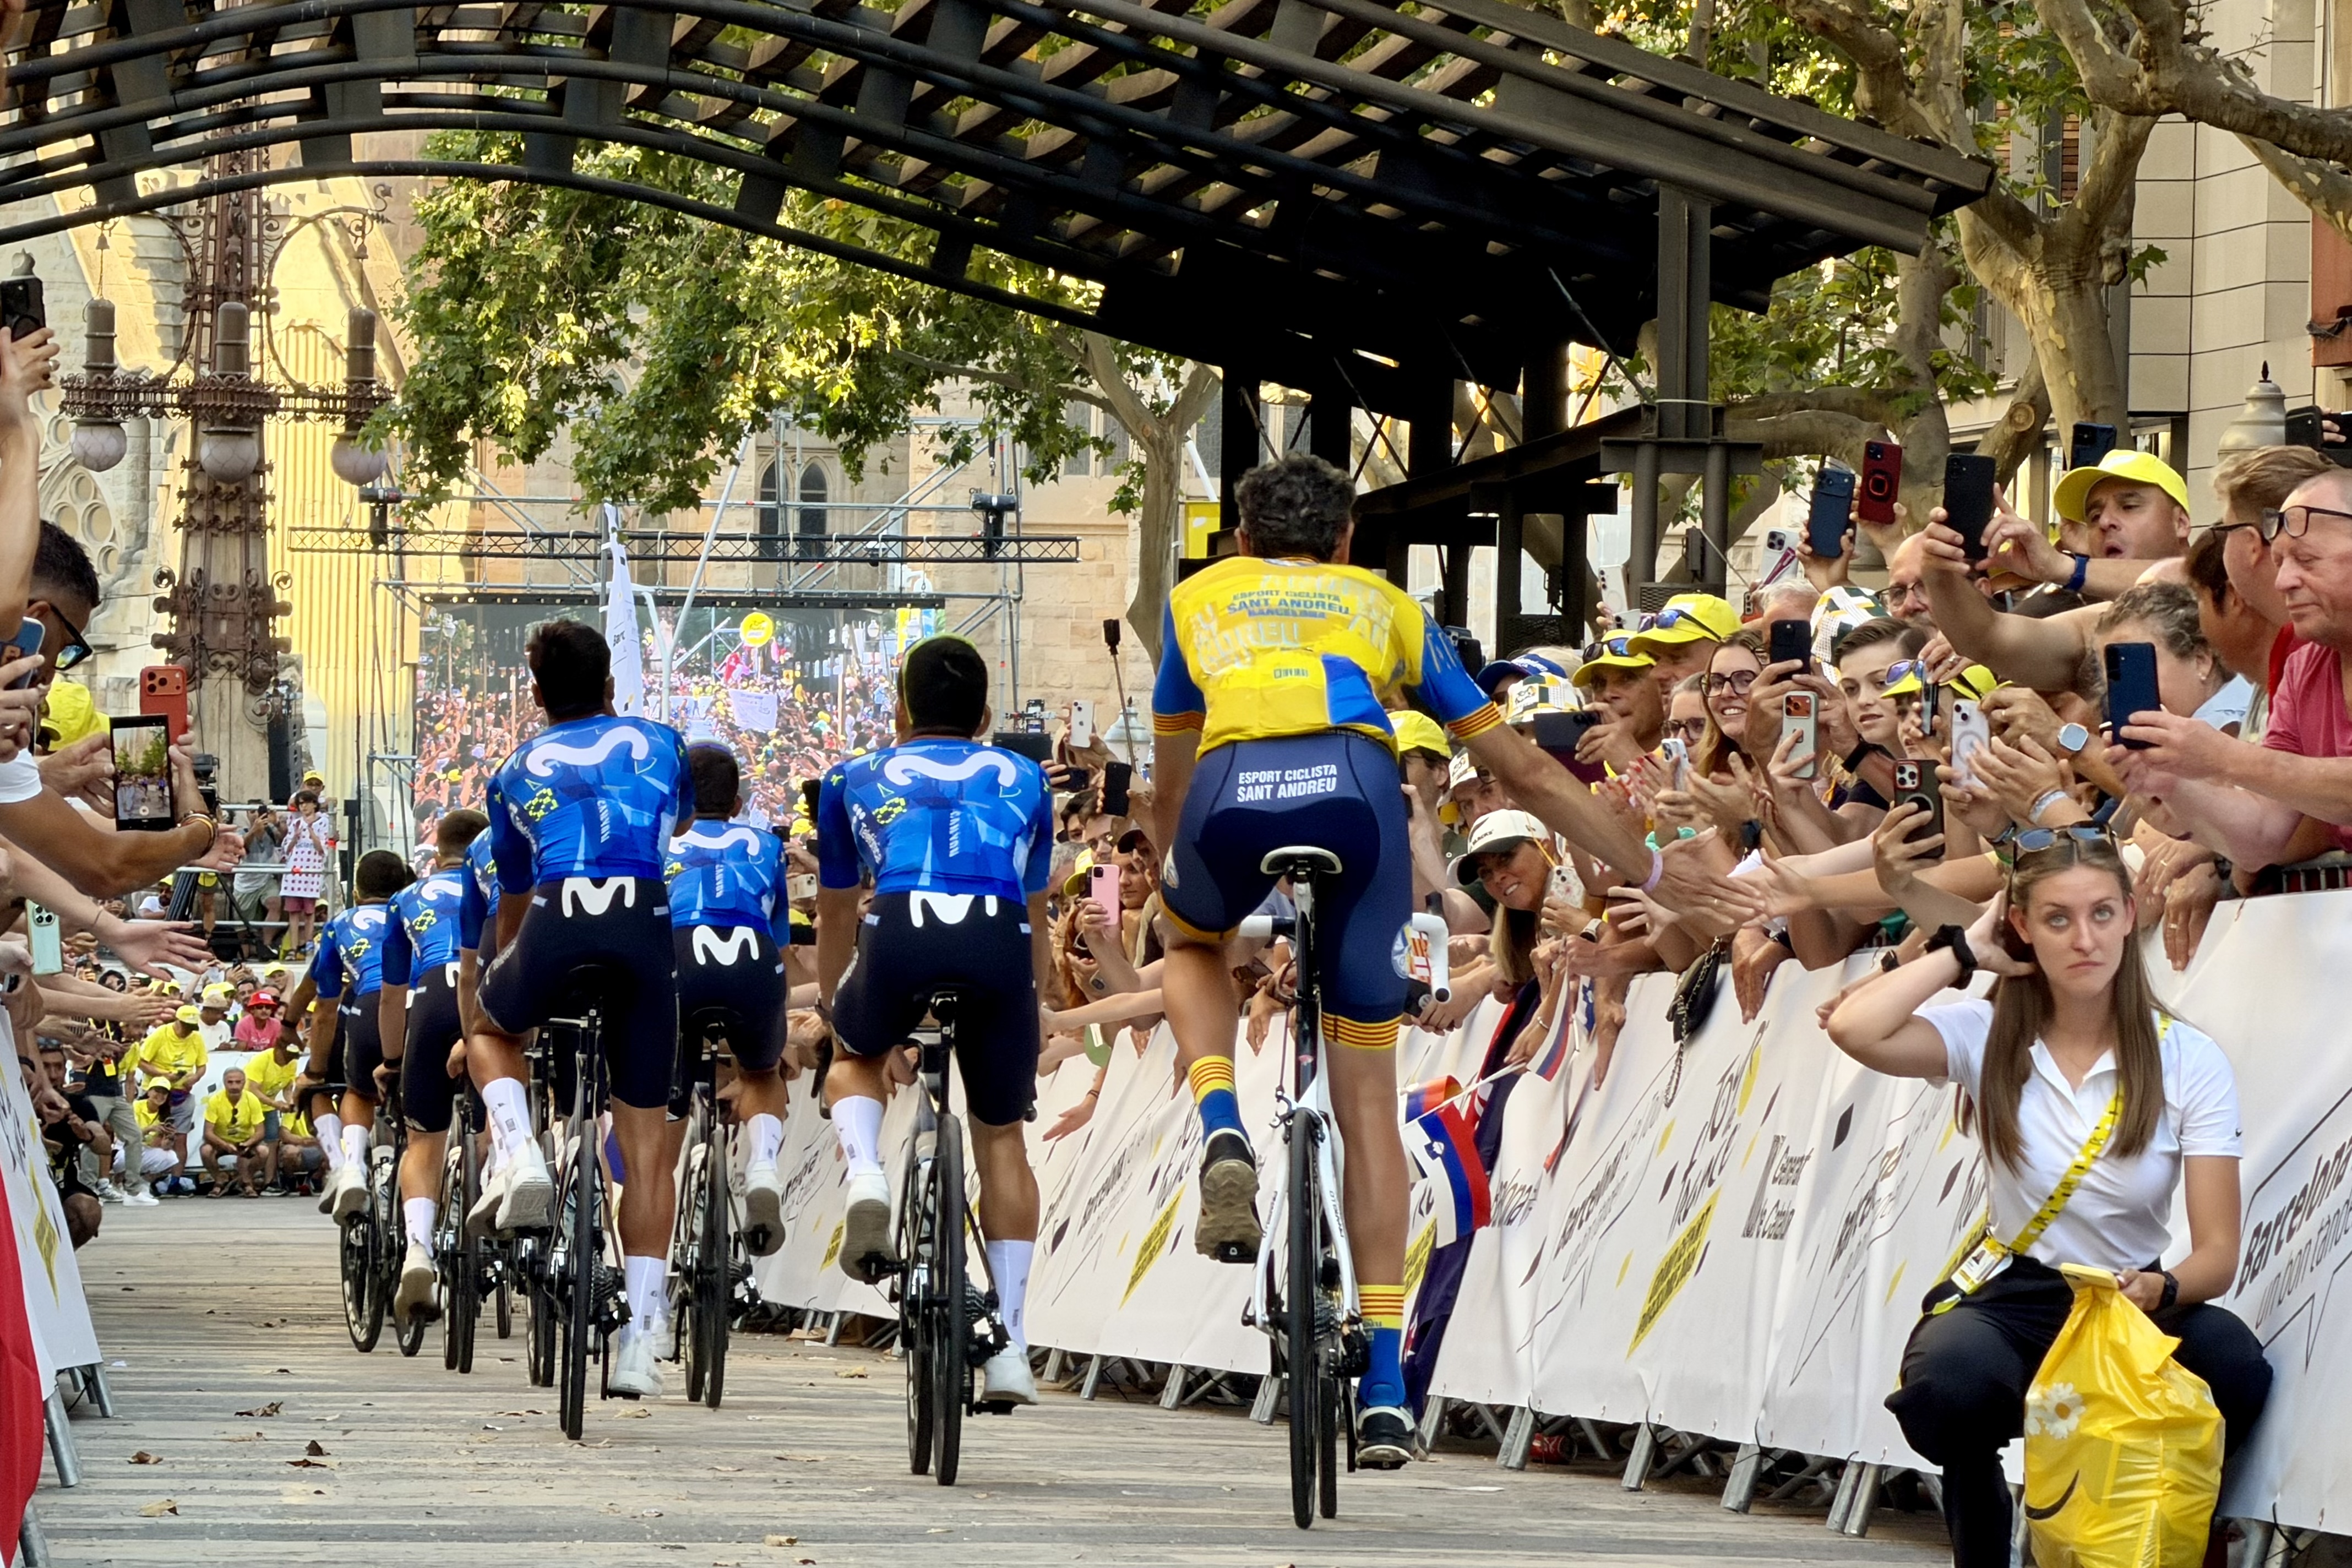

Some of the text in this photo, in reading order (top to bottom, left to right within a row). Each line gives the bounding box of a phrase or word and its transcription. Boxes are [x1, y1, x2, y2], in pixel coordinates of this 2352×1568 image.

[1227, 597, 1349, 615] SANT ANDREU
[1233, 590, 1280, 601] ESPORT
[1238, 764, 1338, 785] ESPORT CICLISTA
[1237, 777, 1337, 803] SANT ANDREU
[2234, 1135, 2352, 1300] Barcelona
[2255, 1271, 2282, 1330] un
[2277, 1237, 2312, 1308] bon
